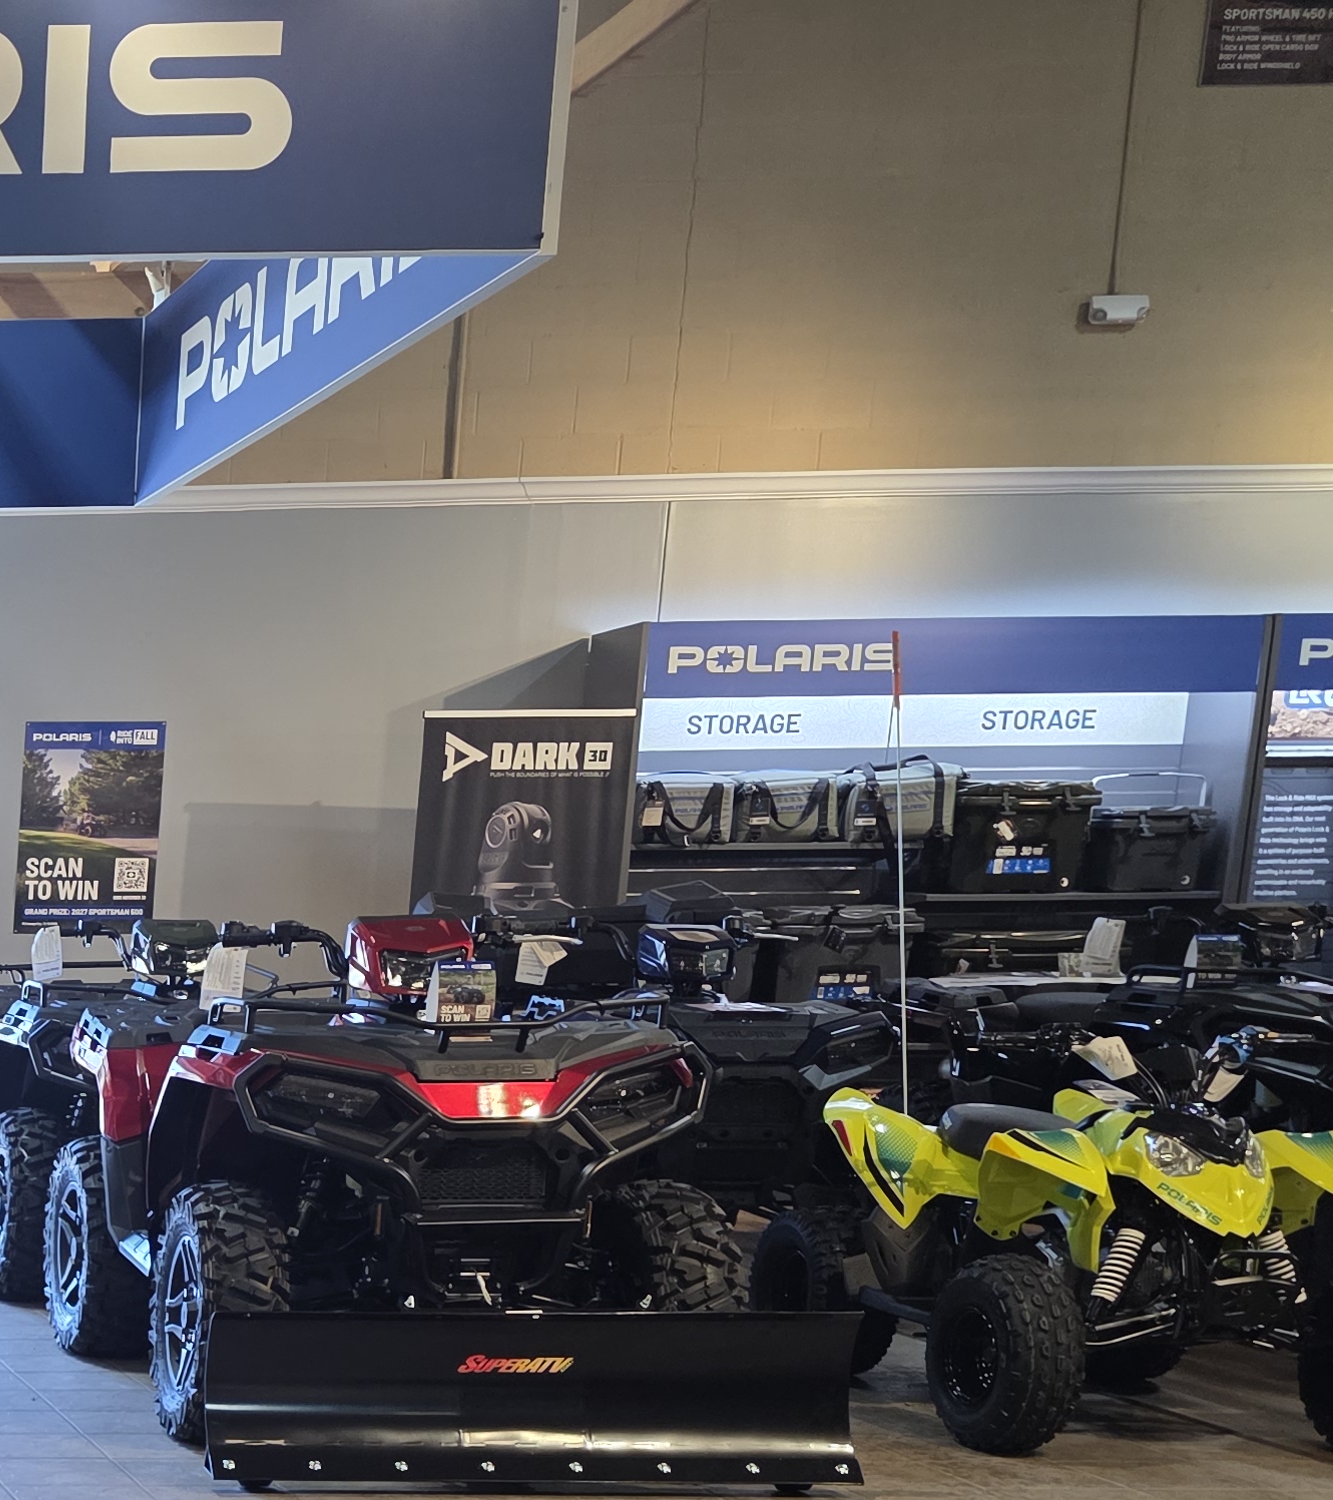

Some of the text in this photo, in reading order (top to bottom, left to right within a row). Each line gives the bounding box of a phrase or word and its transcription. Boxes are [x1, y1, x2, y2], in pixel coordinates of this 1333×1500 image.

[1223, 7, 1300, 20] SPORTSMAN
[1302, 8, 1326, 19] 450
[667, 643, 897, 674] POLARIS
[686, 714, 802, 735] STORAGE
[981, 709, 1097, 731] STORAGE
[33, 732, 93, 742] POLARIS
[134, 731, 156, 741] FALL
[490, 742, 581, 770] DARK
[25, 857, 84, 878] SCAN
[25, 880, 99, 900] TO WIN
[440, 1005, 465, 1014] SCAN
[440, 1014, 471, 1023] TO WIN
[435, 1062, 538, 1077] POLARIS
[1156, 1182, 1223, 1226] POLARIS
